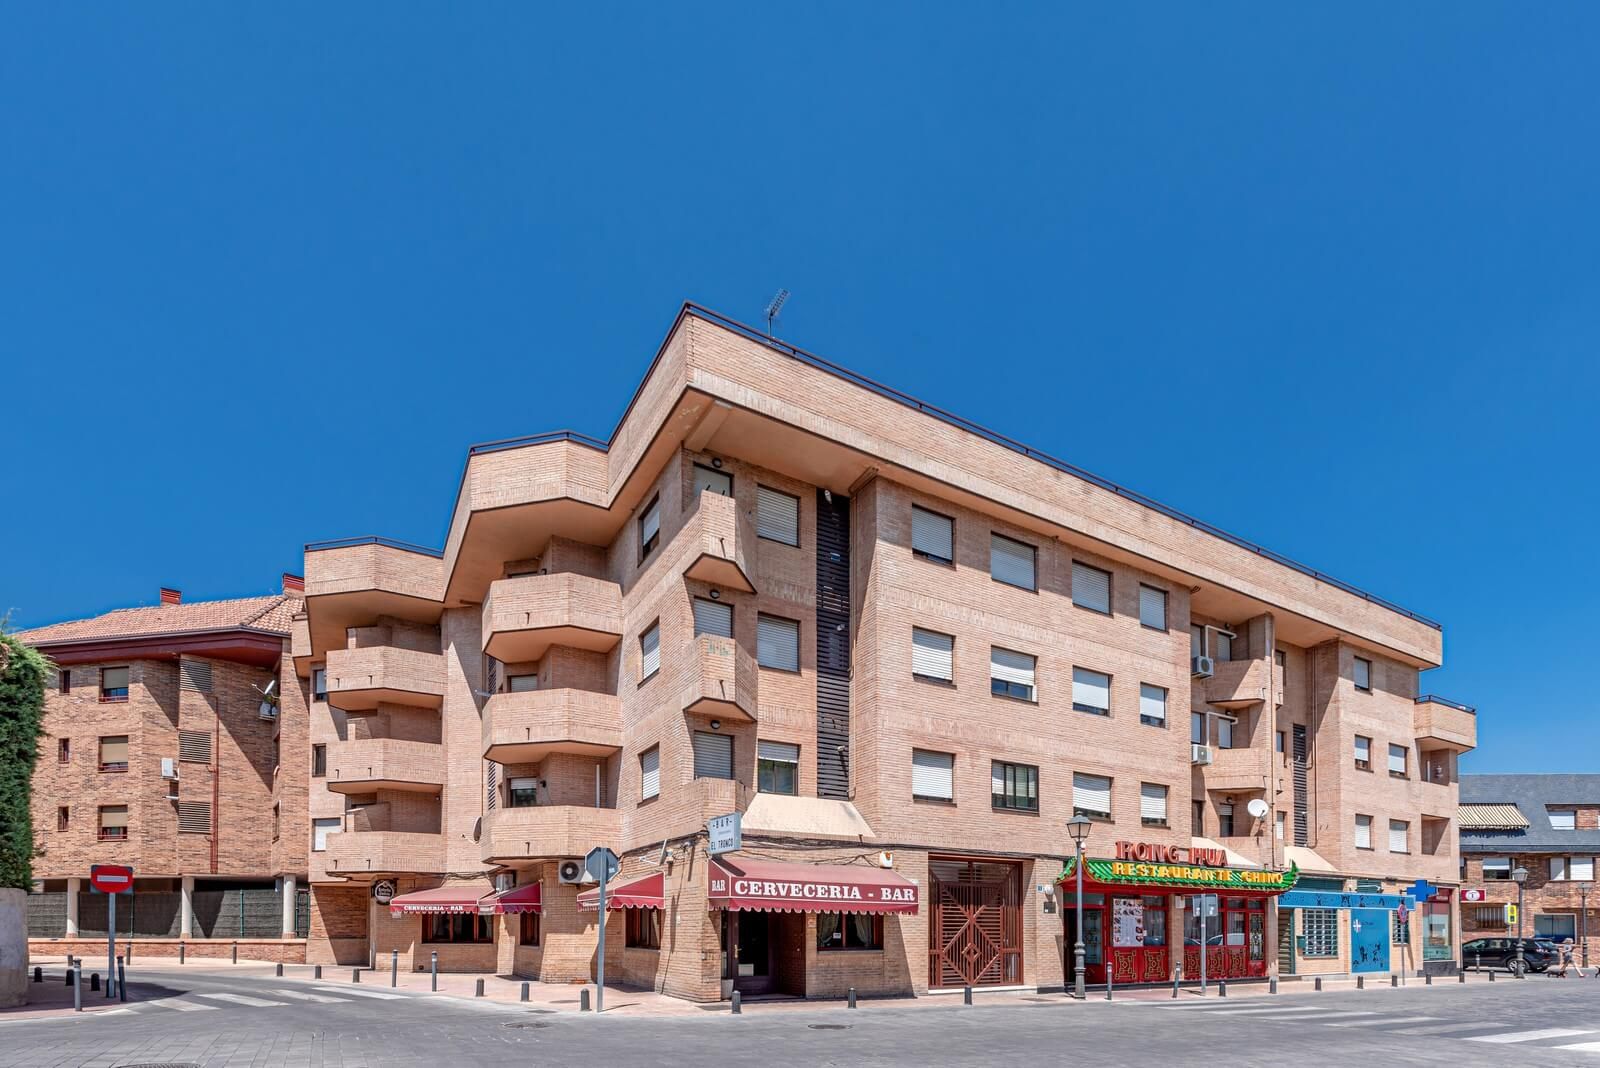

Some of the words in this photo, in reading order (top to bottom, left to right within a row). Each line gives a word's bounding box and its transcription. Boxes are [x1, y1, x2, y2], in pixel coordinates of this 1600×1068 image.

[1115, 841, 1180, 863] RONG
[1188, 847, 1229, 867] HUA
[1112, 862, 1233, 881] RESTAURANTE
[1241, 871, 1284, 884] CHINO
[711, 879, 726, 892] BAR
[735, 880, 861, 899] CERVECERIA
[880, 887, 915, 902] BAR
